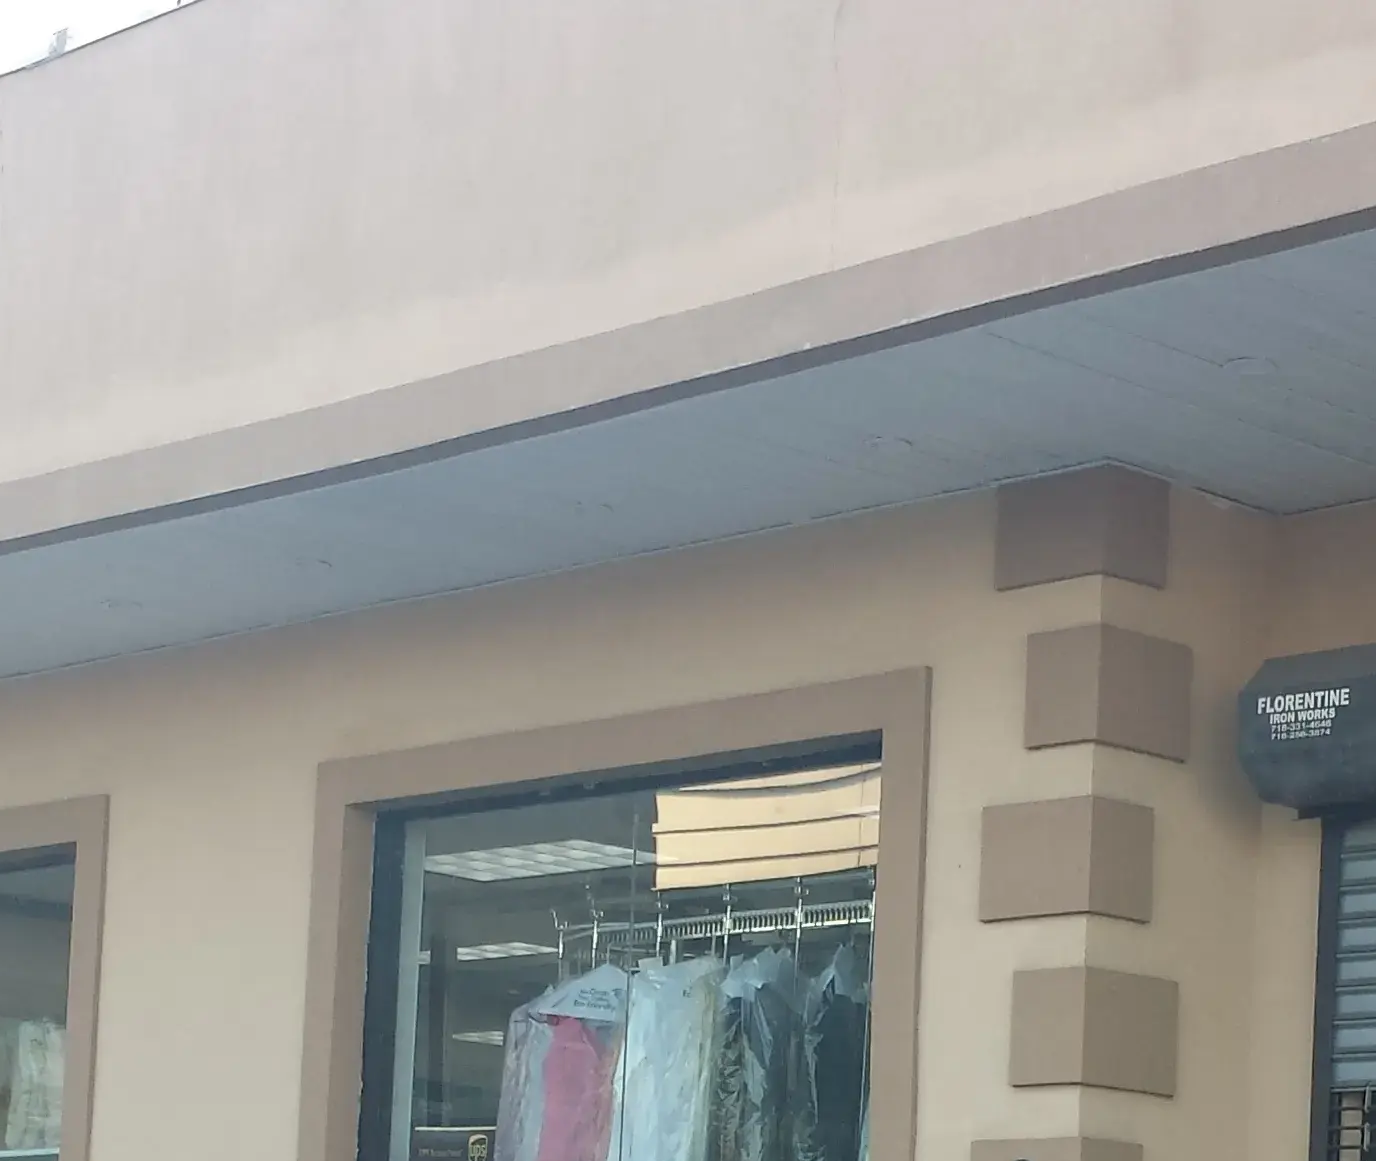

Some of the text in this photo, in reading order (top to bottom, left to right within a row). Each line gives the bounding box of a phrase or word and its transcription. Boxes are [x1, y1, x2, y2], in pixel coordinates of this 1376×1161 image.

[1256, 687, 1350, 715] FLORENTINE
[1269, 707, 1336, 724] IRON WORKS
